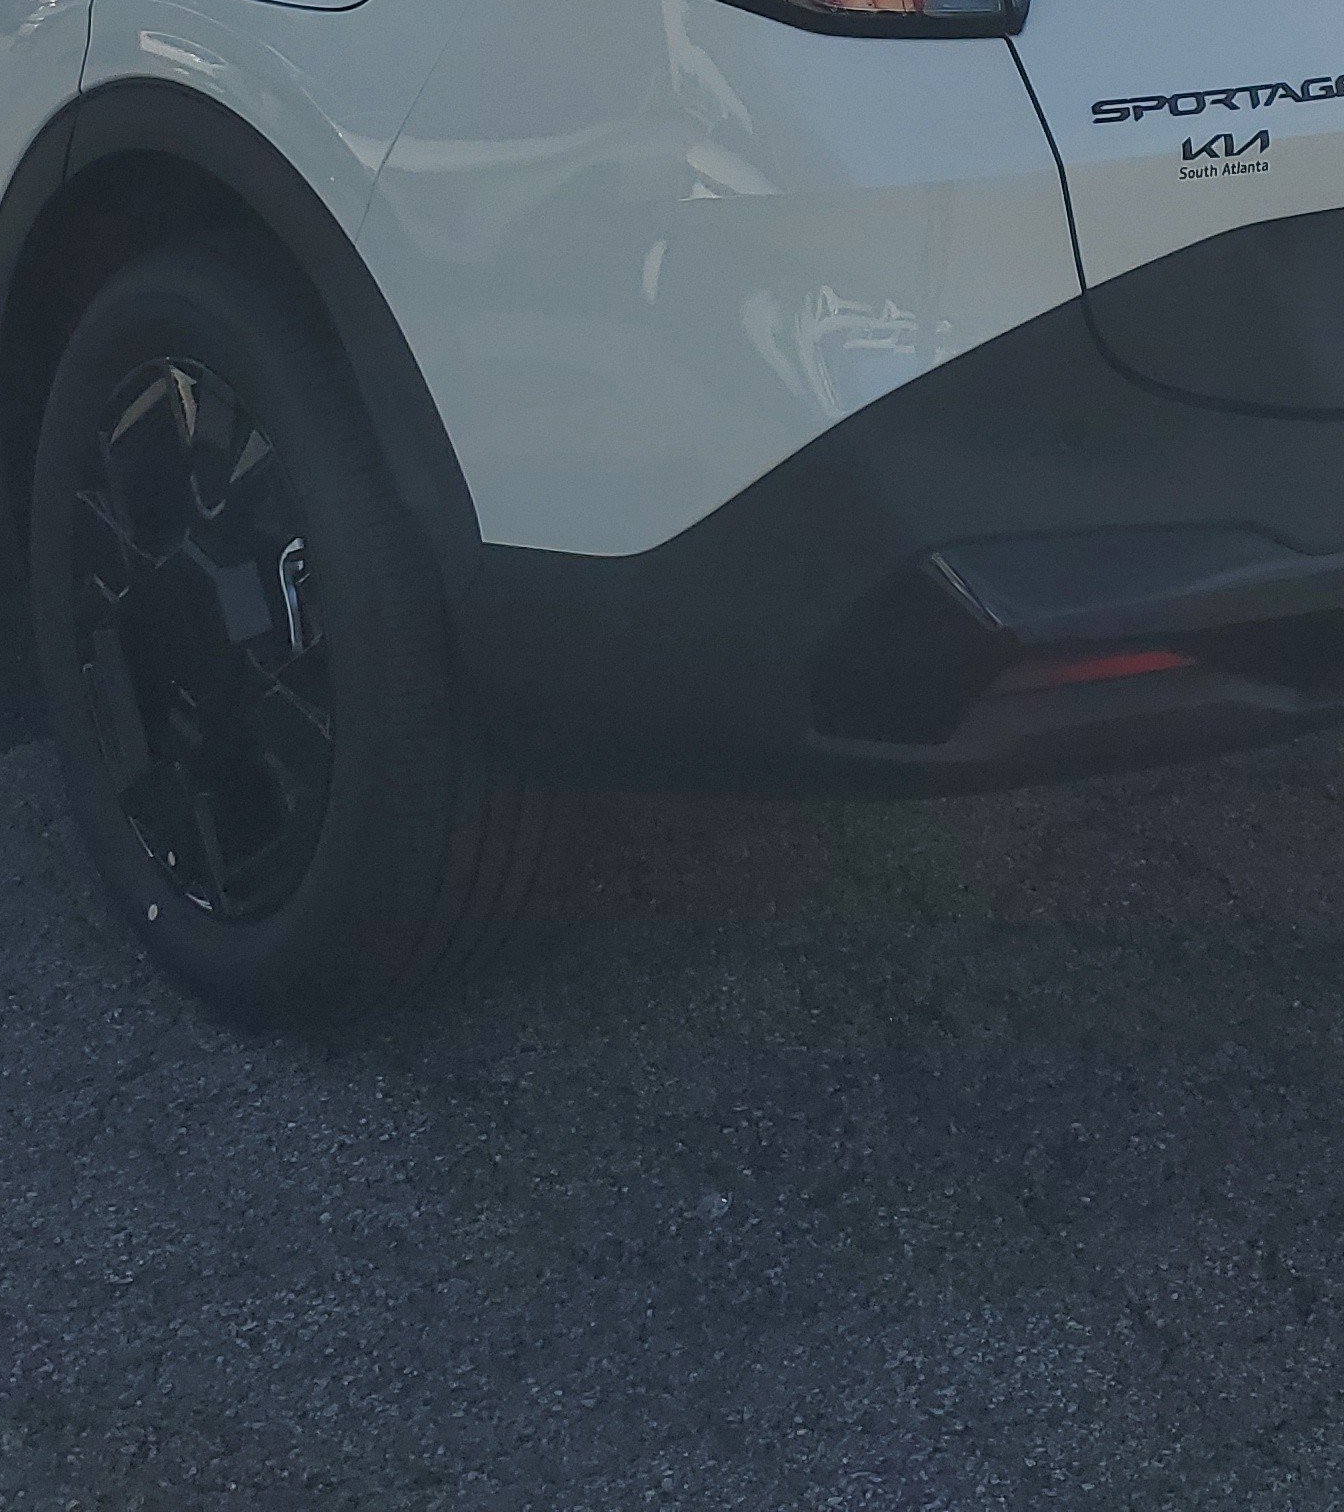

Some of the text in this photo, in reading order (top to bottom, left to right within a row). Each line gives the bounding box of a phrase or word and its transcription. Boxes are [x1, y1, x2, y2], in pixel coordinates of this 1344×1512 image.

[1181, 129, 1270, 161] KIA
[1179, 159, 1269, 180] South Atlanta
